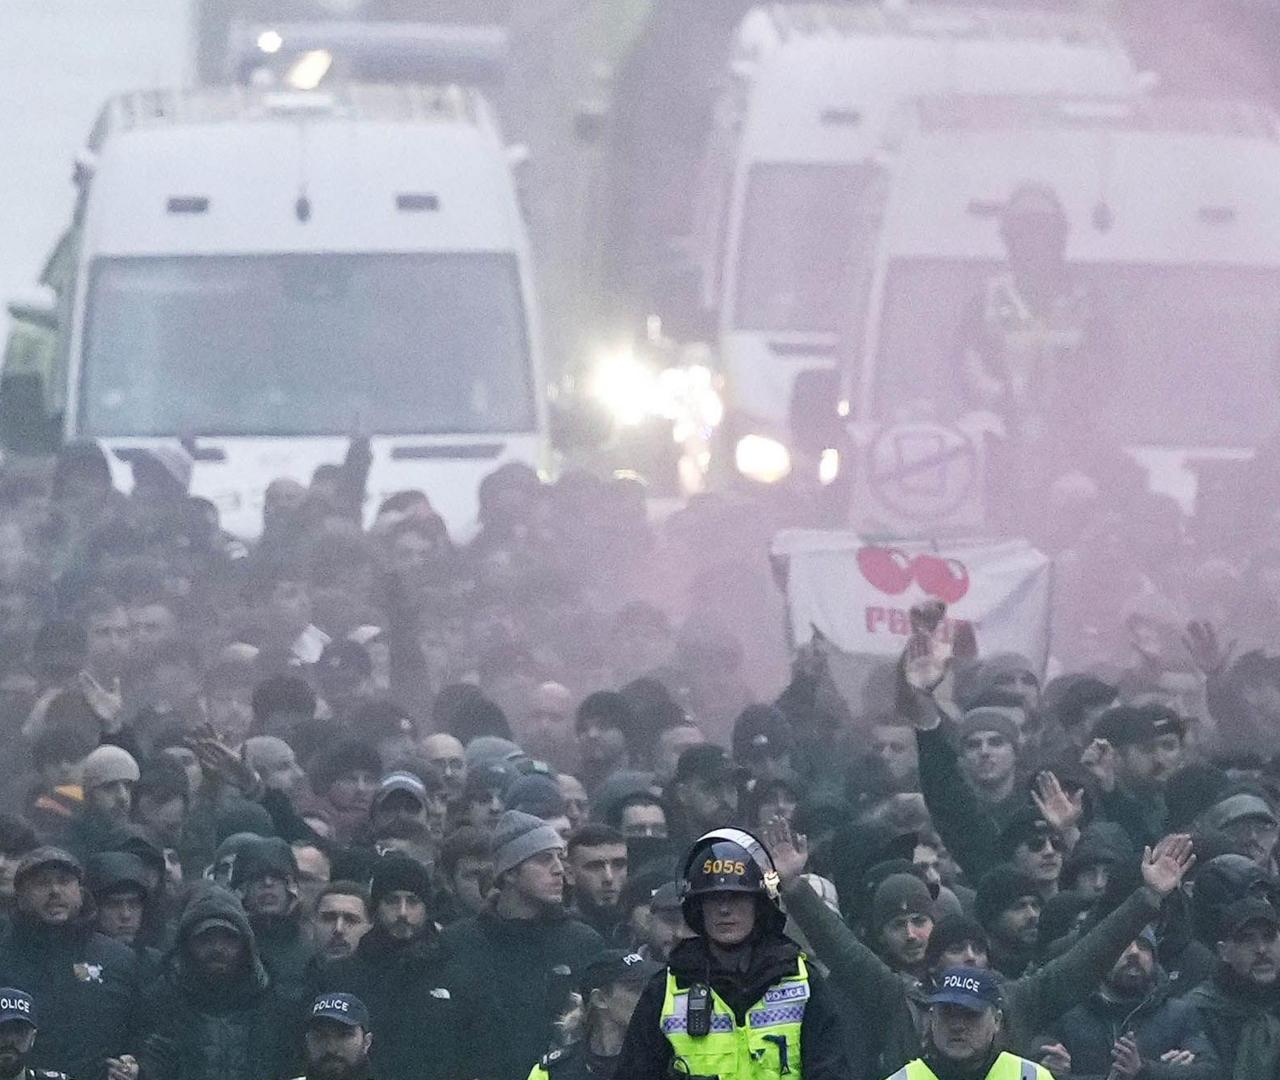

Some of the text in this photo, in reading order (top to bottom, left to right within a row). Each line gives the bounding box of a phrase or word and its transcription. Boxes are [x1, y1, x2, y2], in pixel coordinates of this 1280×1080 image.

[703, 859, 746, 876] 5055
[943, 975, 980, 993] POLICE
[766, 985, 805, 1003] POLICE
[313, 999, 350, 1015] POLICE
